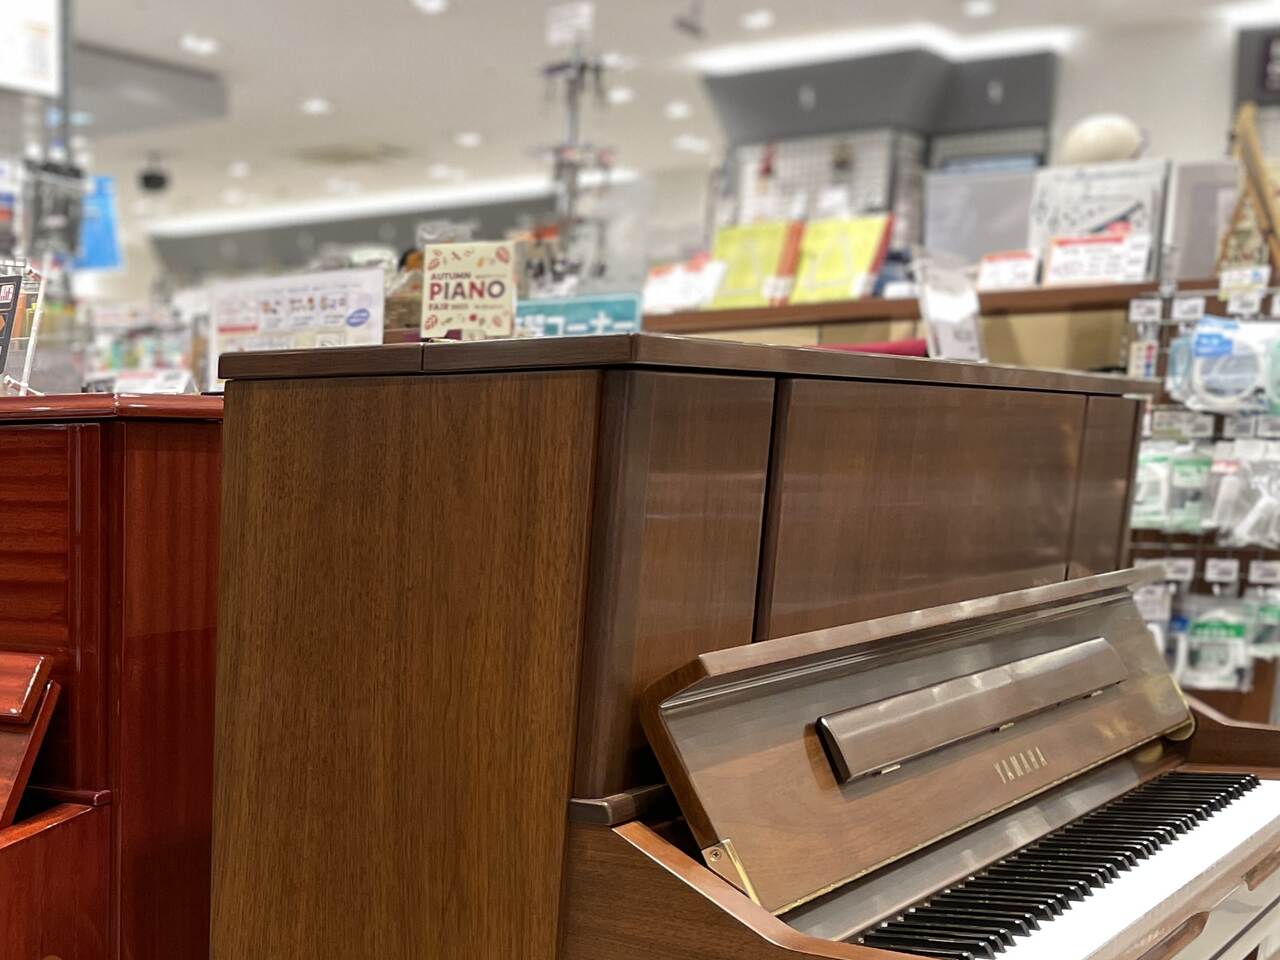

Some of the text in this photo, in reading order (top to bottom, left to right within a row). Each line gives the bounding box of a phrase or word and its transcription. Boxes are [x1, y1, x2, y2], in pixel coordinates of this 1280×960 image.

[431, 272, 471, 280] AUTUMN
[429, 280, 506, 300] PIANO
[993, 746, 1048, 784] YAMAHA
